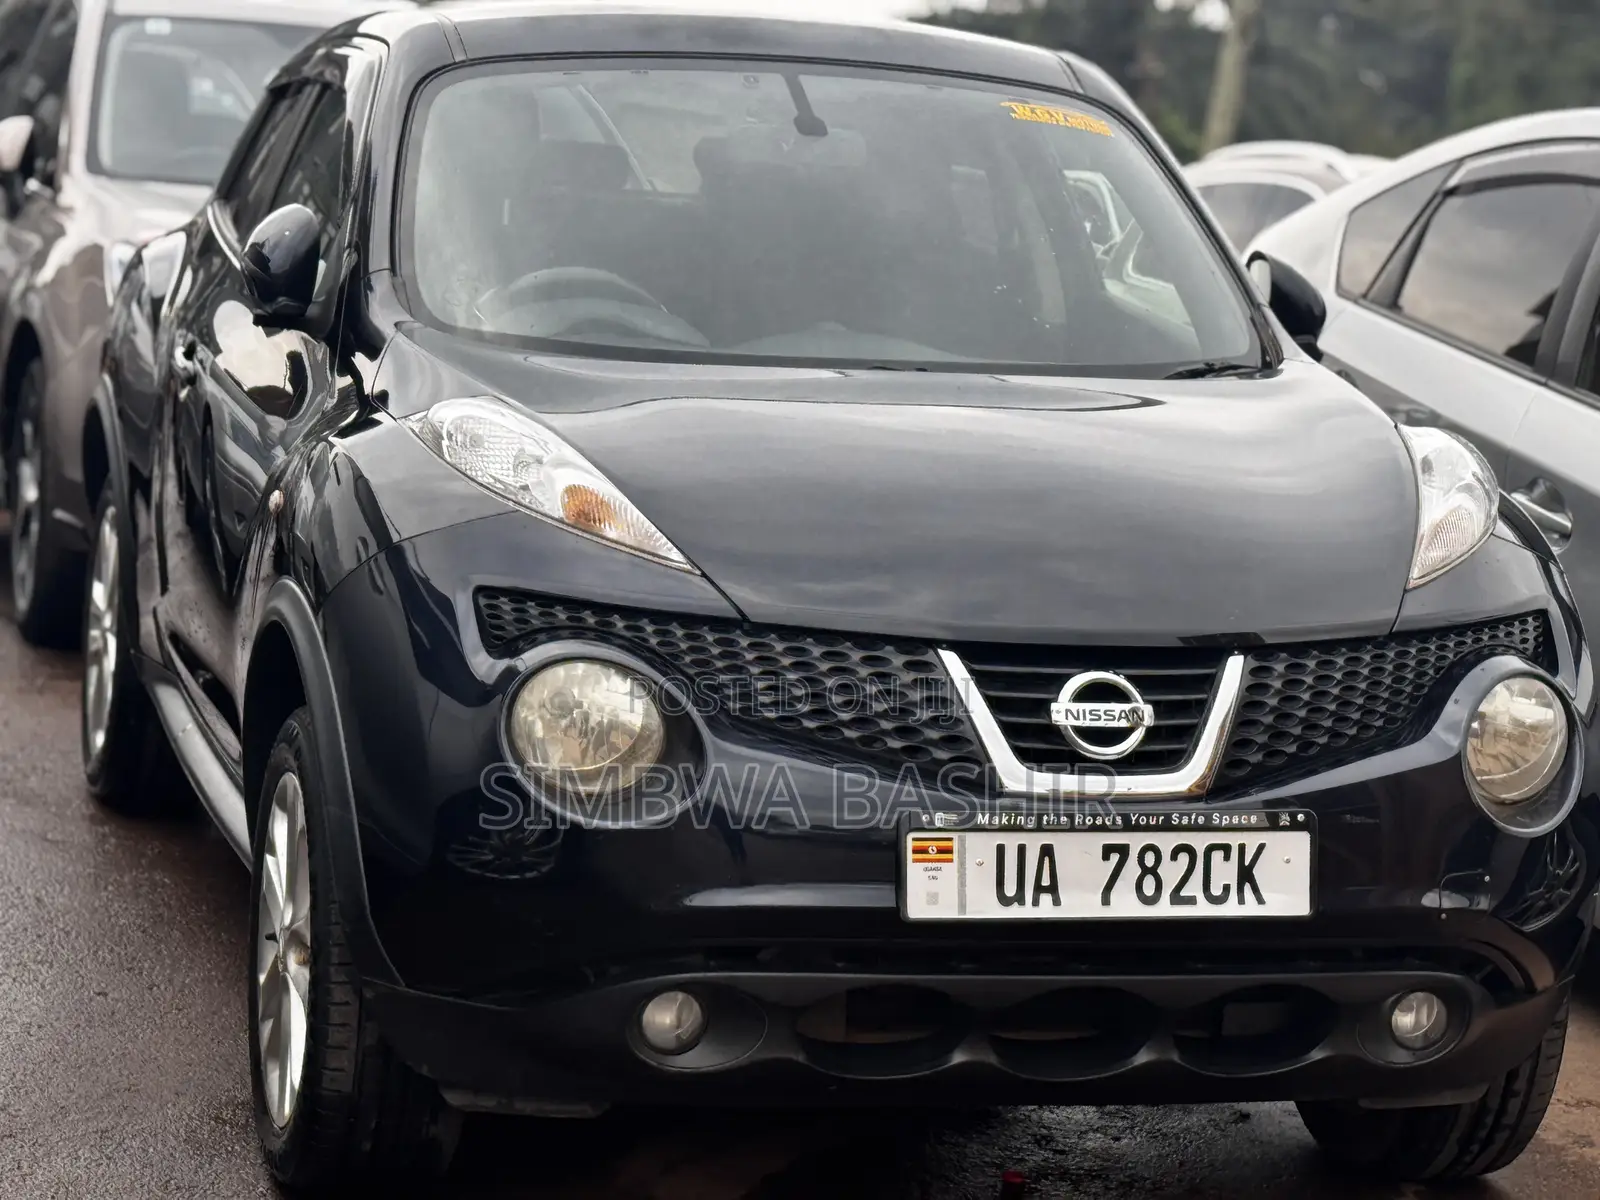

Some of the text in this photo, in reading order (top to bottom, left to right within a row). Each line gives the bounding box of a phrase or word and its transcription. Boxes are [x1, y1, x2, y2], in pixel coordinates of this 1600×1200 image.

[1064, 707, 1145, 723] NISSAN
[977, 812, 1258, 828] Making the Roads Your Safe Space
[995, 842, 1267, 907] UA 782CK
